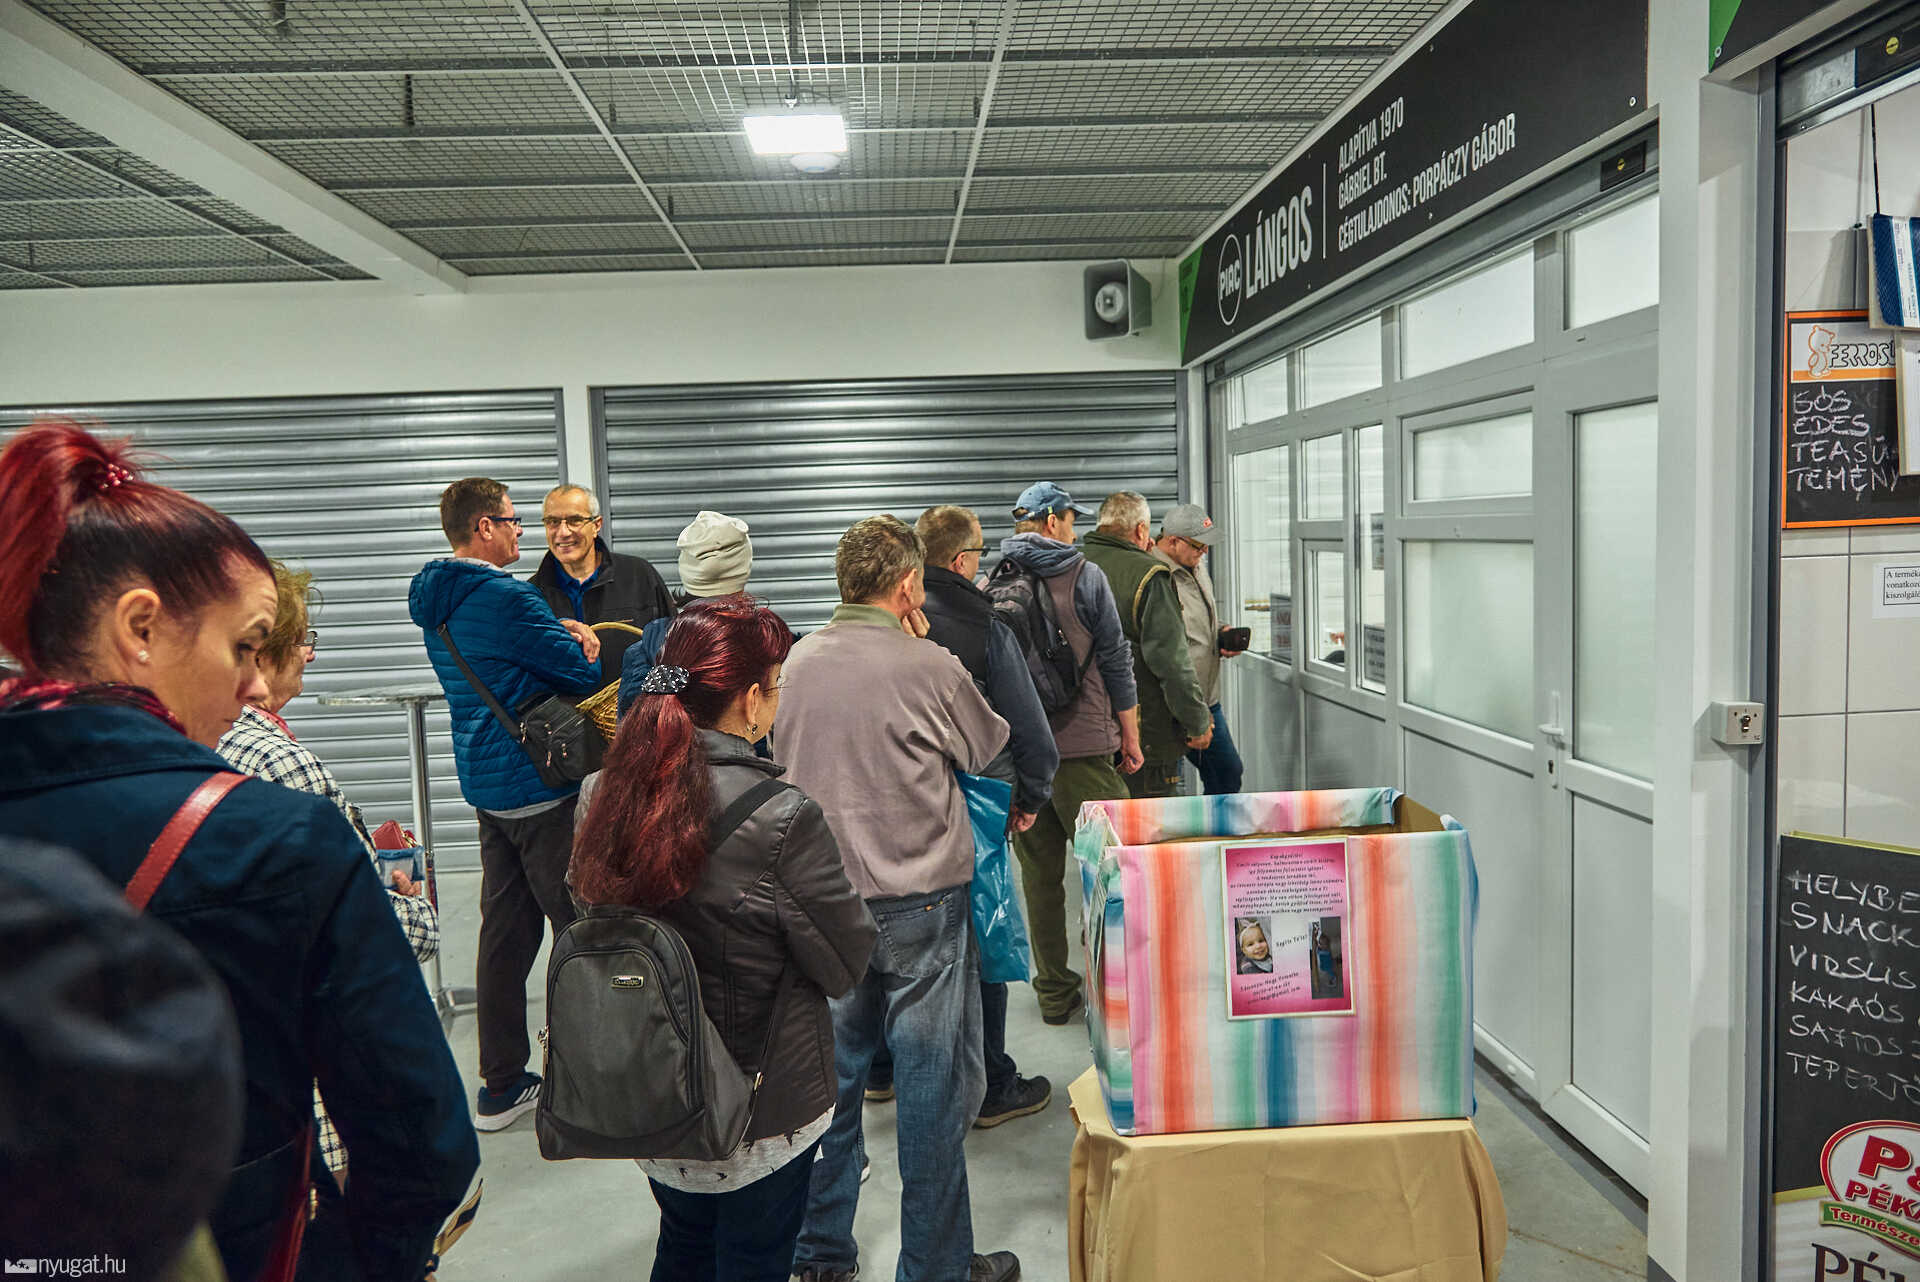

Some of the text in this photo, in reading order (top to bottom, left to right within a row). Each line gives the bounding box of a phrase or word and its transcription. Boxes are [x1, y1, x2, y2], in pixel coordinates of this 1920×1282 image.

[1338, 96, 1404, 174] ALAPÍTVA 1970
[1338, 151, 1387, 210] GÁBRIEL BT.
[1338, 112, 1516, 252] CÉGTULAJDONOS: PORPÁCZY GÁBOR
[1245, 186, 1313, 299] LÁNGOS
[1219, 259, 1241, 300] PIAC
[1790, 902, 1920, 949] SNACK
[1789, 944, 1917, 989] VIRSLIS
[1790, 980, 1905, 1022] KAKAÓS
[1845, 1180, 1920, 1223] PÉK
